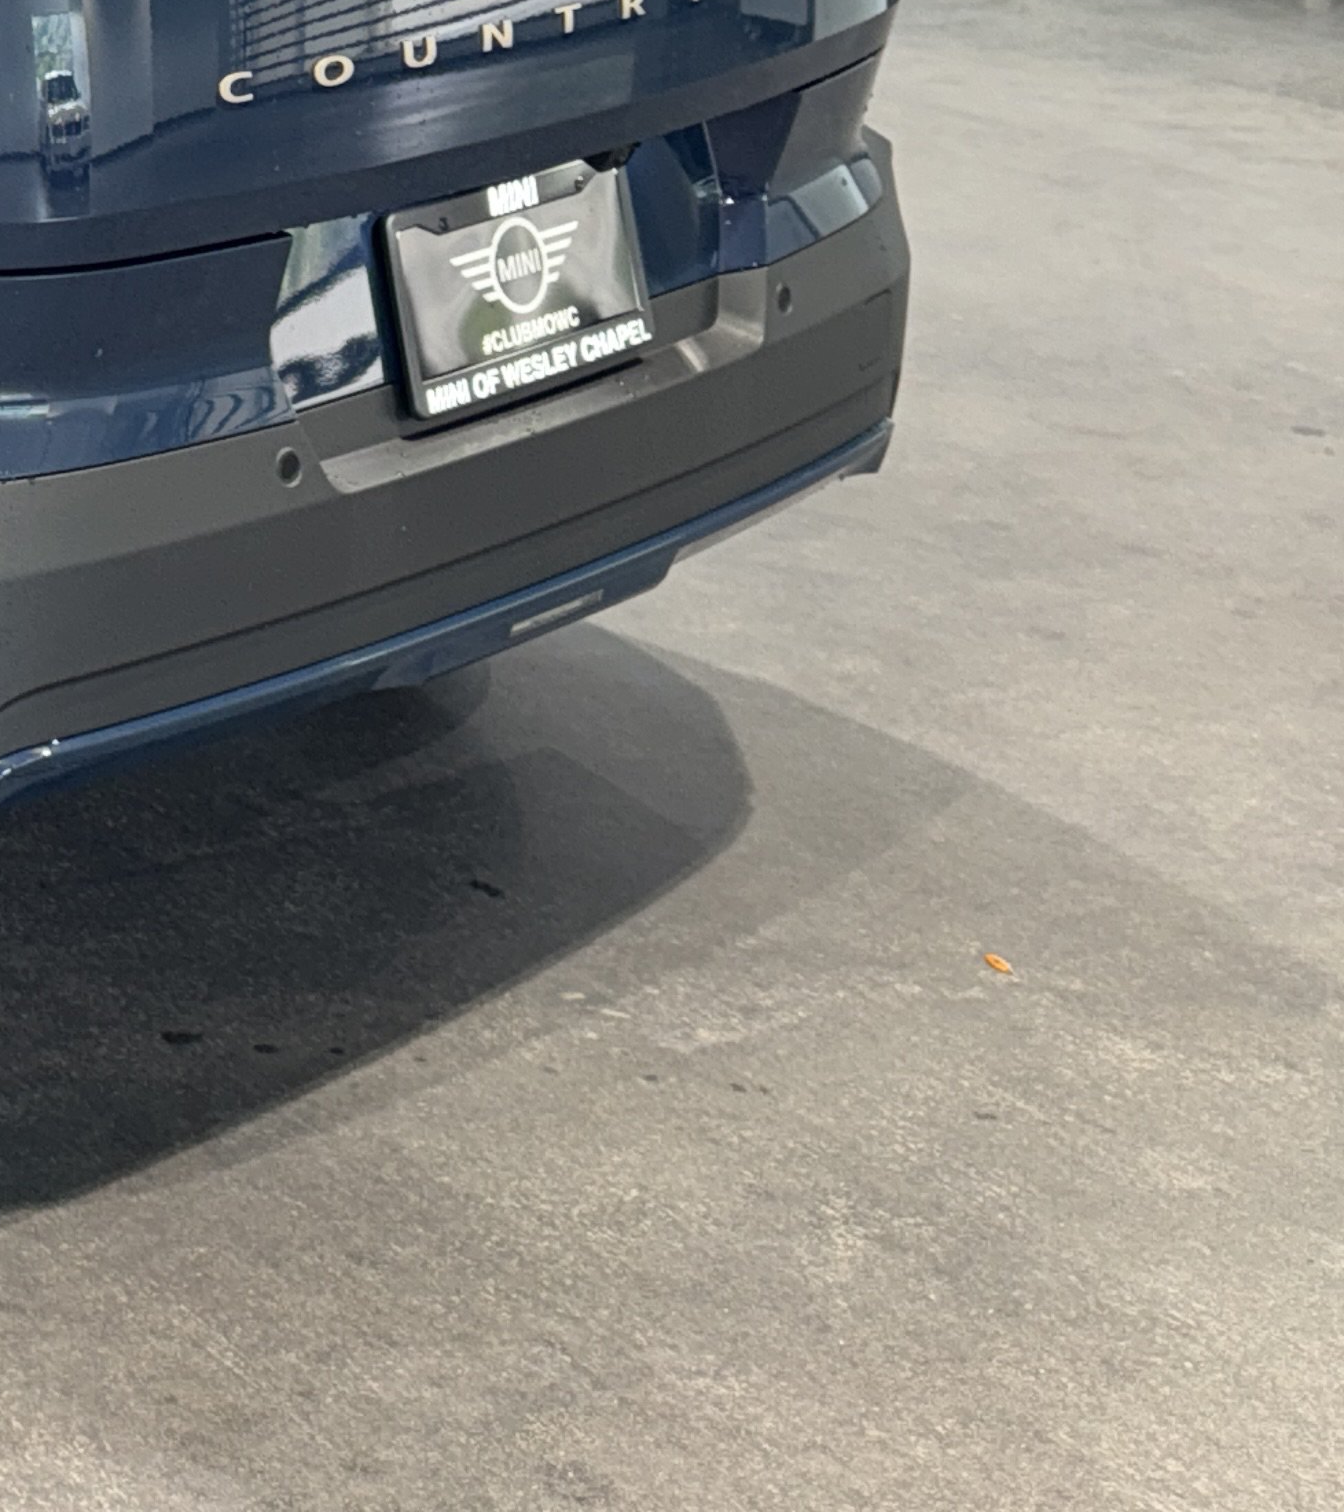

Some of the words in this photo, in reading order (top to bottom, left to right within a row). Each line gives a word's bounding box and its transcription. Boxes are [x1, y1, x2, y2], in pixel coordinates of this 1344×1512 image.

[487, 175, 539, 217] MINI
[497, 247, 542, 283] MINI
[482, 306, 580, 355] #CLUBMOWC
[426, 385, 472, 415] MINI
[473, 372, 501, 400] OF
[502, 343, 579, 388] WESLEY
[580, 319, 653, 363] CHAPEL
